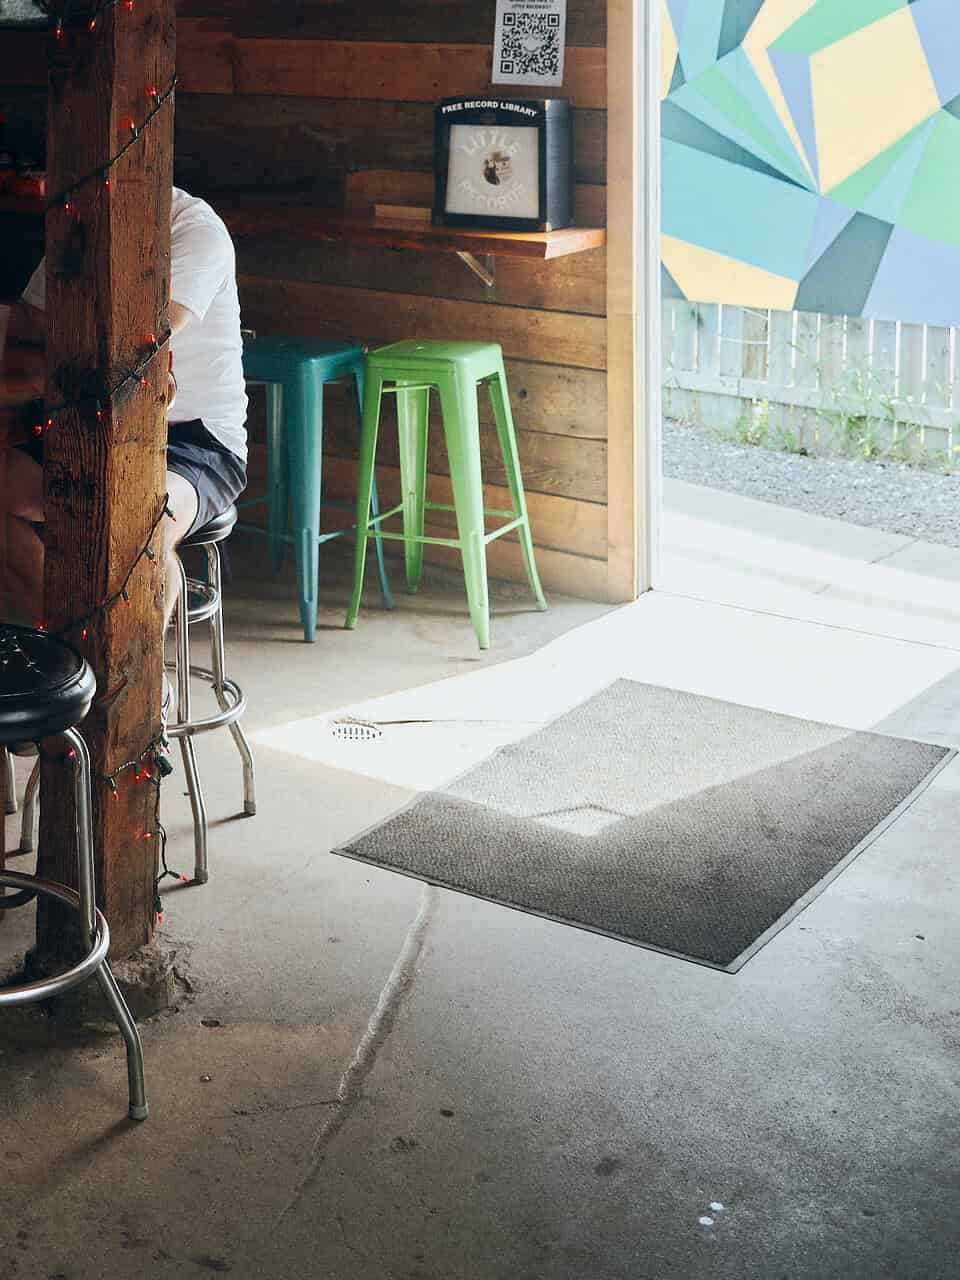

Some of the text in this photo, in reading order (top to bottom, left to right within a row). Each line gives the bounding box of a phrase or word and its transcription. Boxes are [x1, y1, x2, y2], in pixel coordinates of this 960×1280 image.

[442, 100, 537, 117] FREE RECORD LIBRARY
